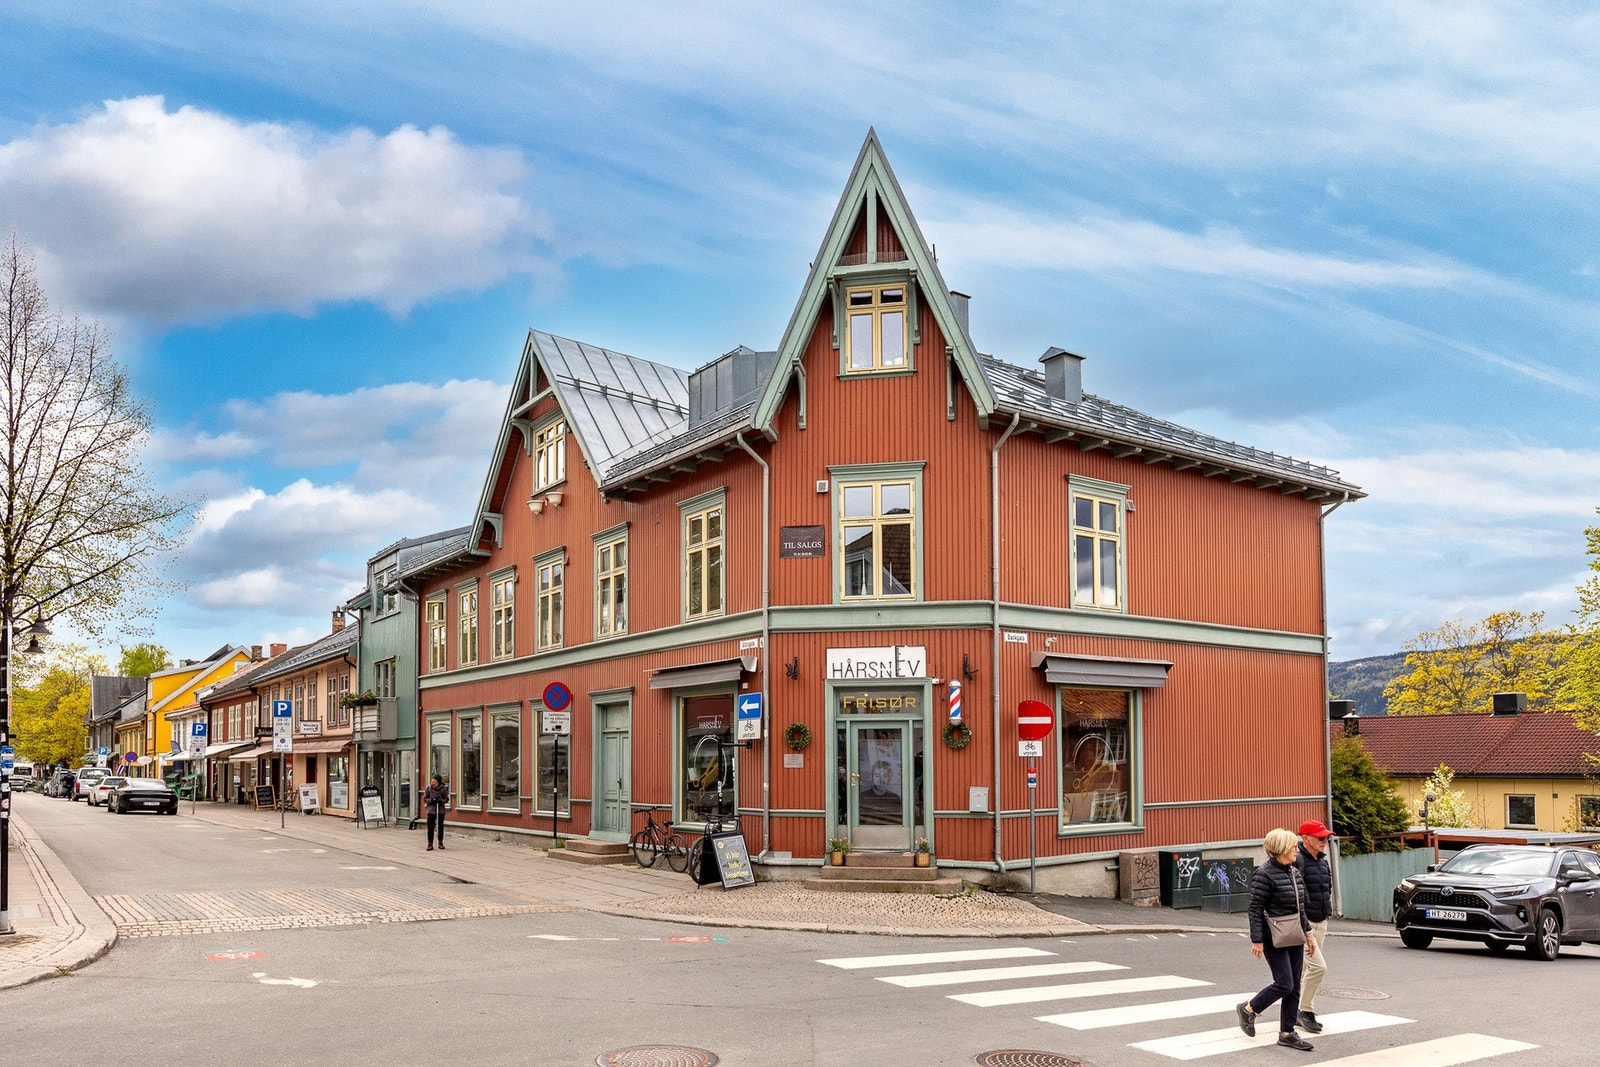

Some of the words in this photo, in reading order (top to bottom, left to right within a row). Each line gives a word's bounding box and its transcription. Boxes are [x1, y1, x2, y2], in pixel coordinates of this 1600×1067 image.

[796, 541, 822, 549] SALGS
[277, 702, 288, 716] P
[195, 724, 204, 735] P
[1443, 911, 1465, 919] 26279
